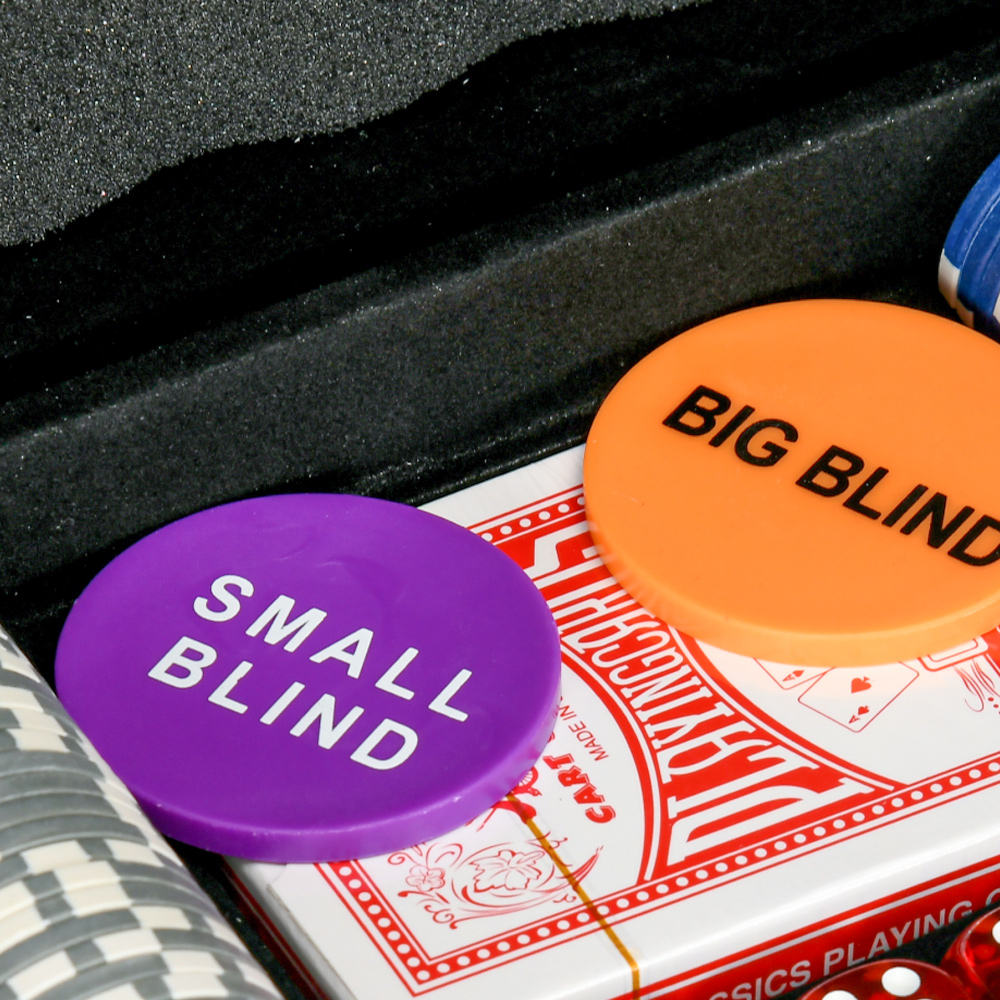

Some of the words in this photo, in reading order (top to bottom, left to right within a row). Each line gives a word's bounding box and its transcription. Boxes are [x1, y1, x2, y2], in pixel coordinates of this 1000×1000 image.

[662, 384, 799, 467] BIG
[192, 573, 473, 722] SMALL
[147, 635, 419, 771] BLIND
[556, 704, 578, 721] IN
[567, 721, 610, 762] MADE
[542, 752, 617, 824] CART
[823, 900, 973, 976] PLAYING
